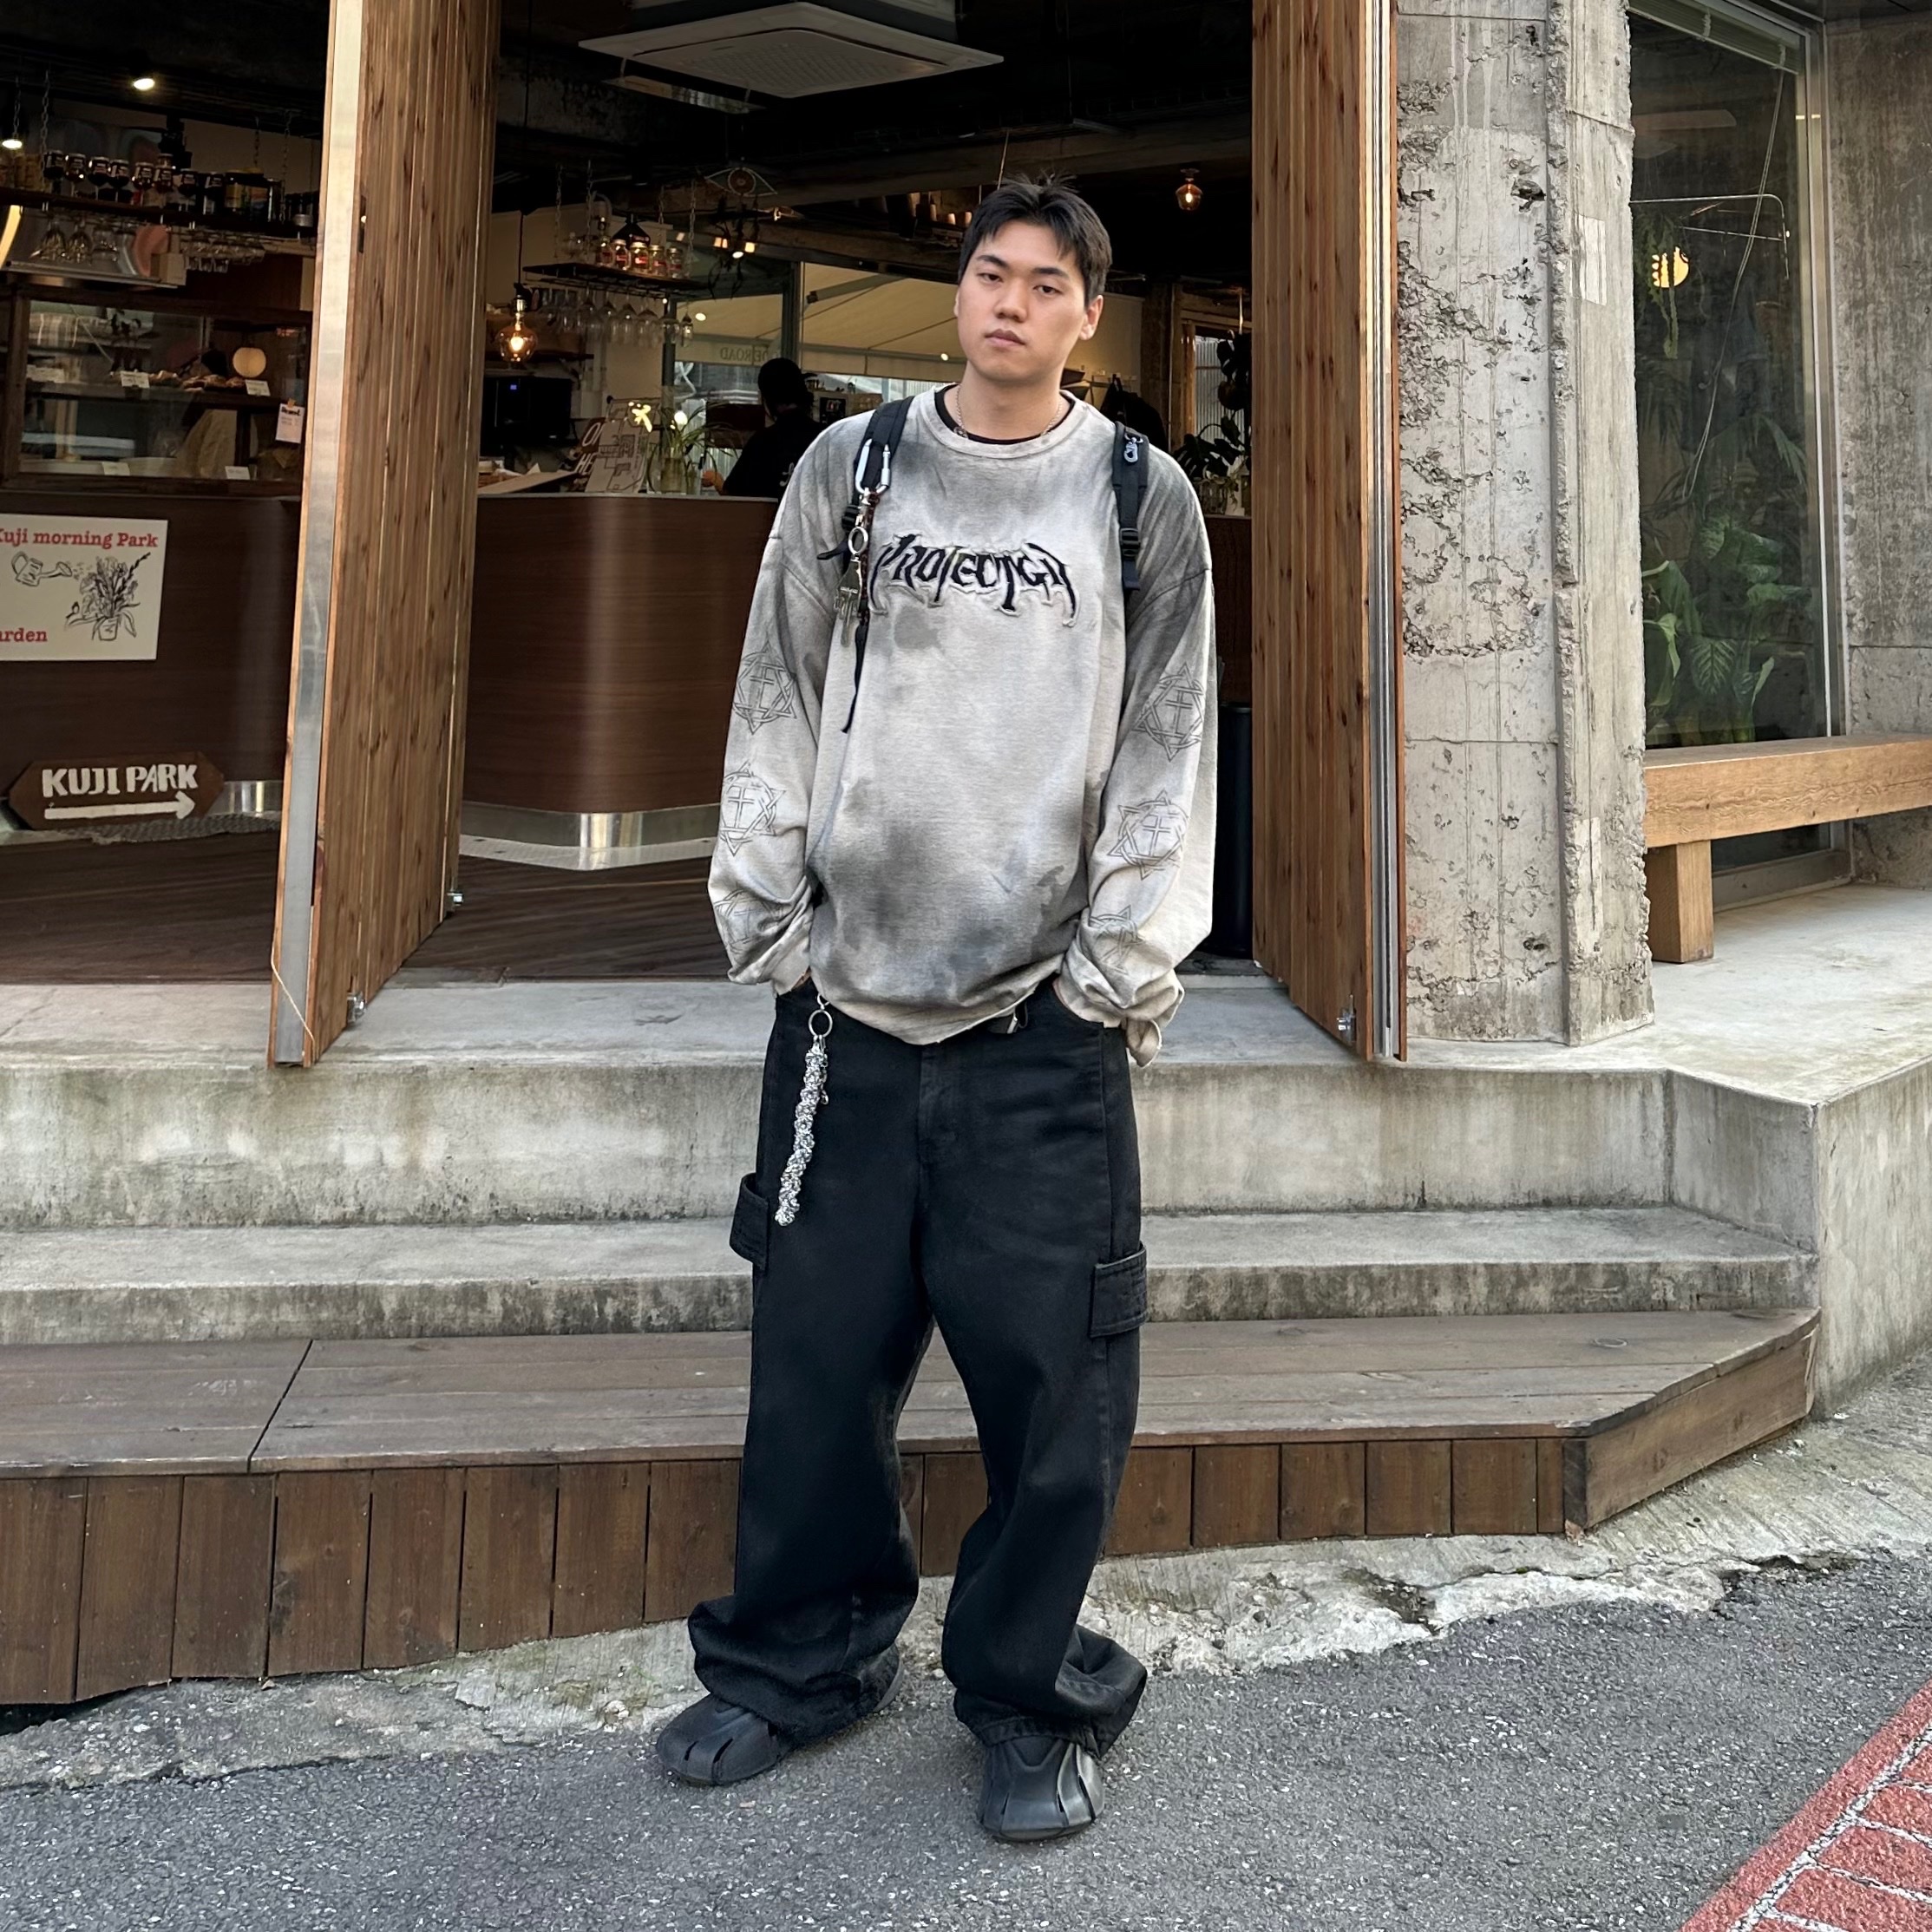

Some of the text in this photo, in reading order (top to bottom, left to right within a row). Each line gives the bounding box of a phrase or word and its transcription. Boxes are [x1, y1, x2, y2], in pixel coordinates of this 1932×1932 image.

[33, 531, 114, 550] morning
[117, 533, 159, 548] Park
[42, 764, 198, 797] KUJI PARK
